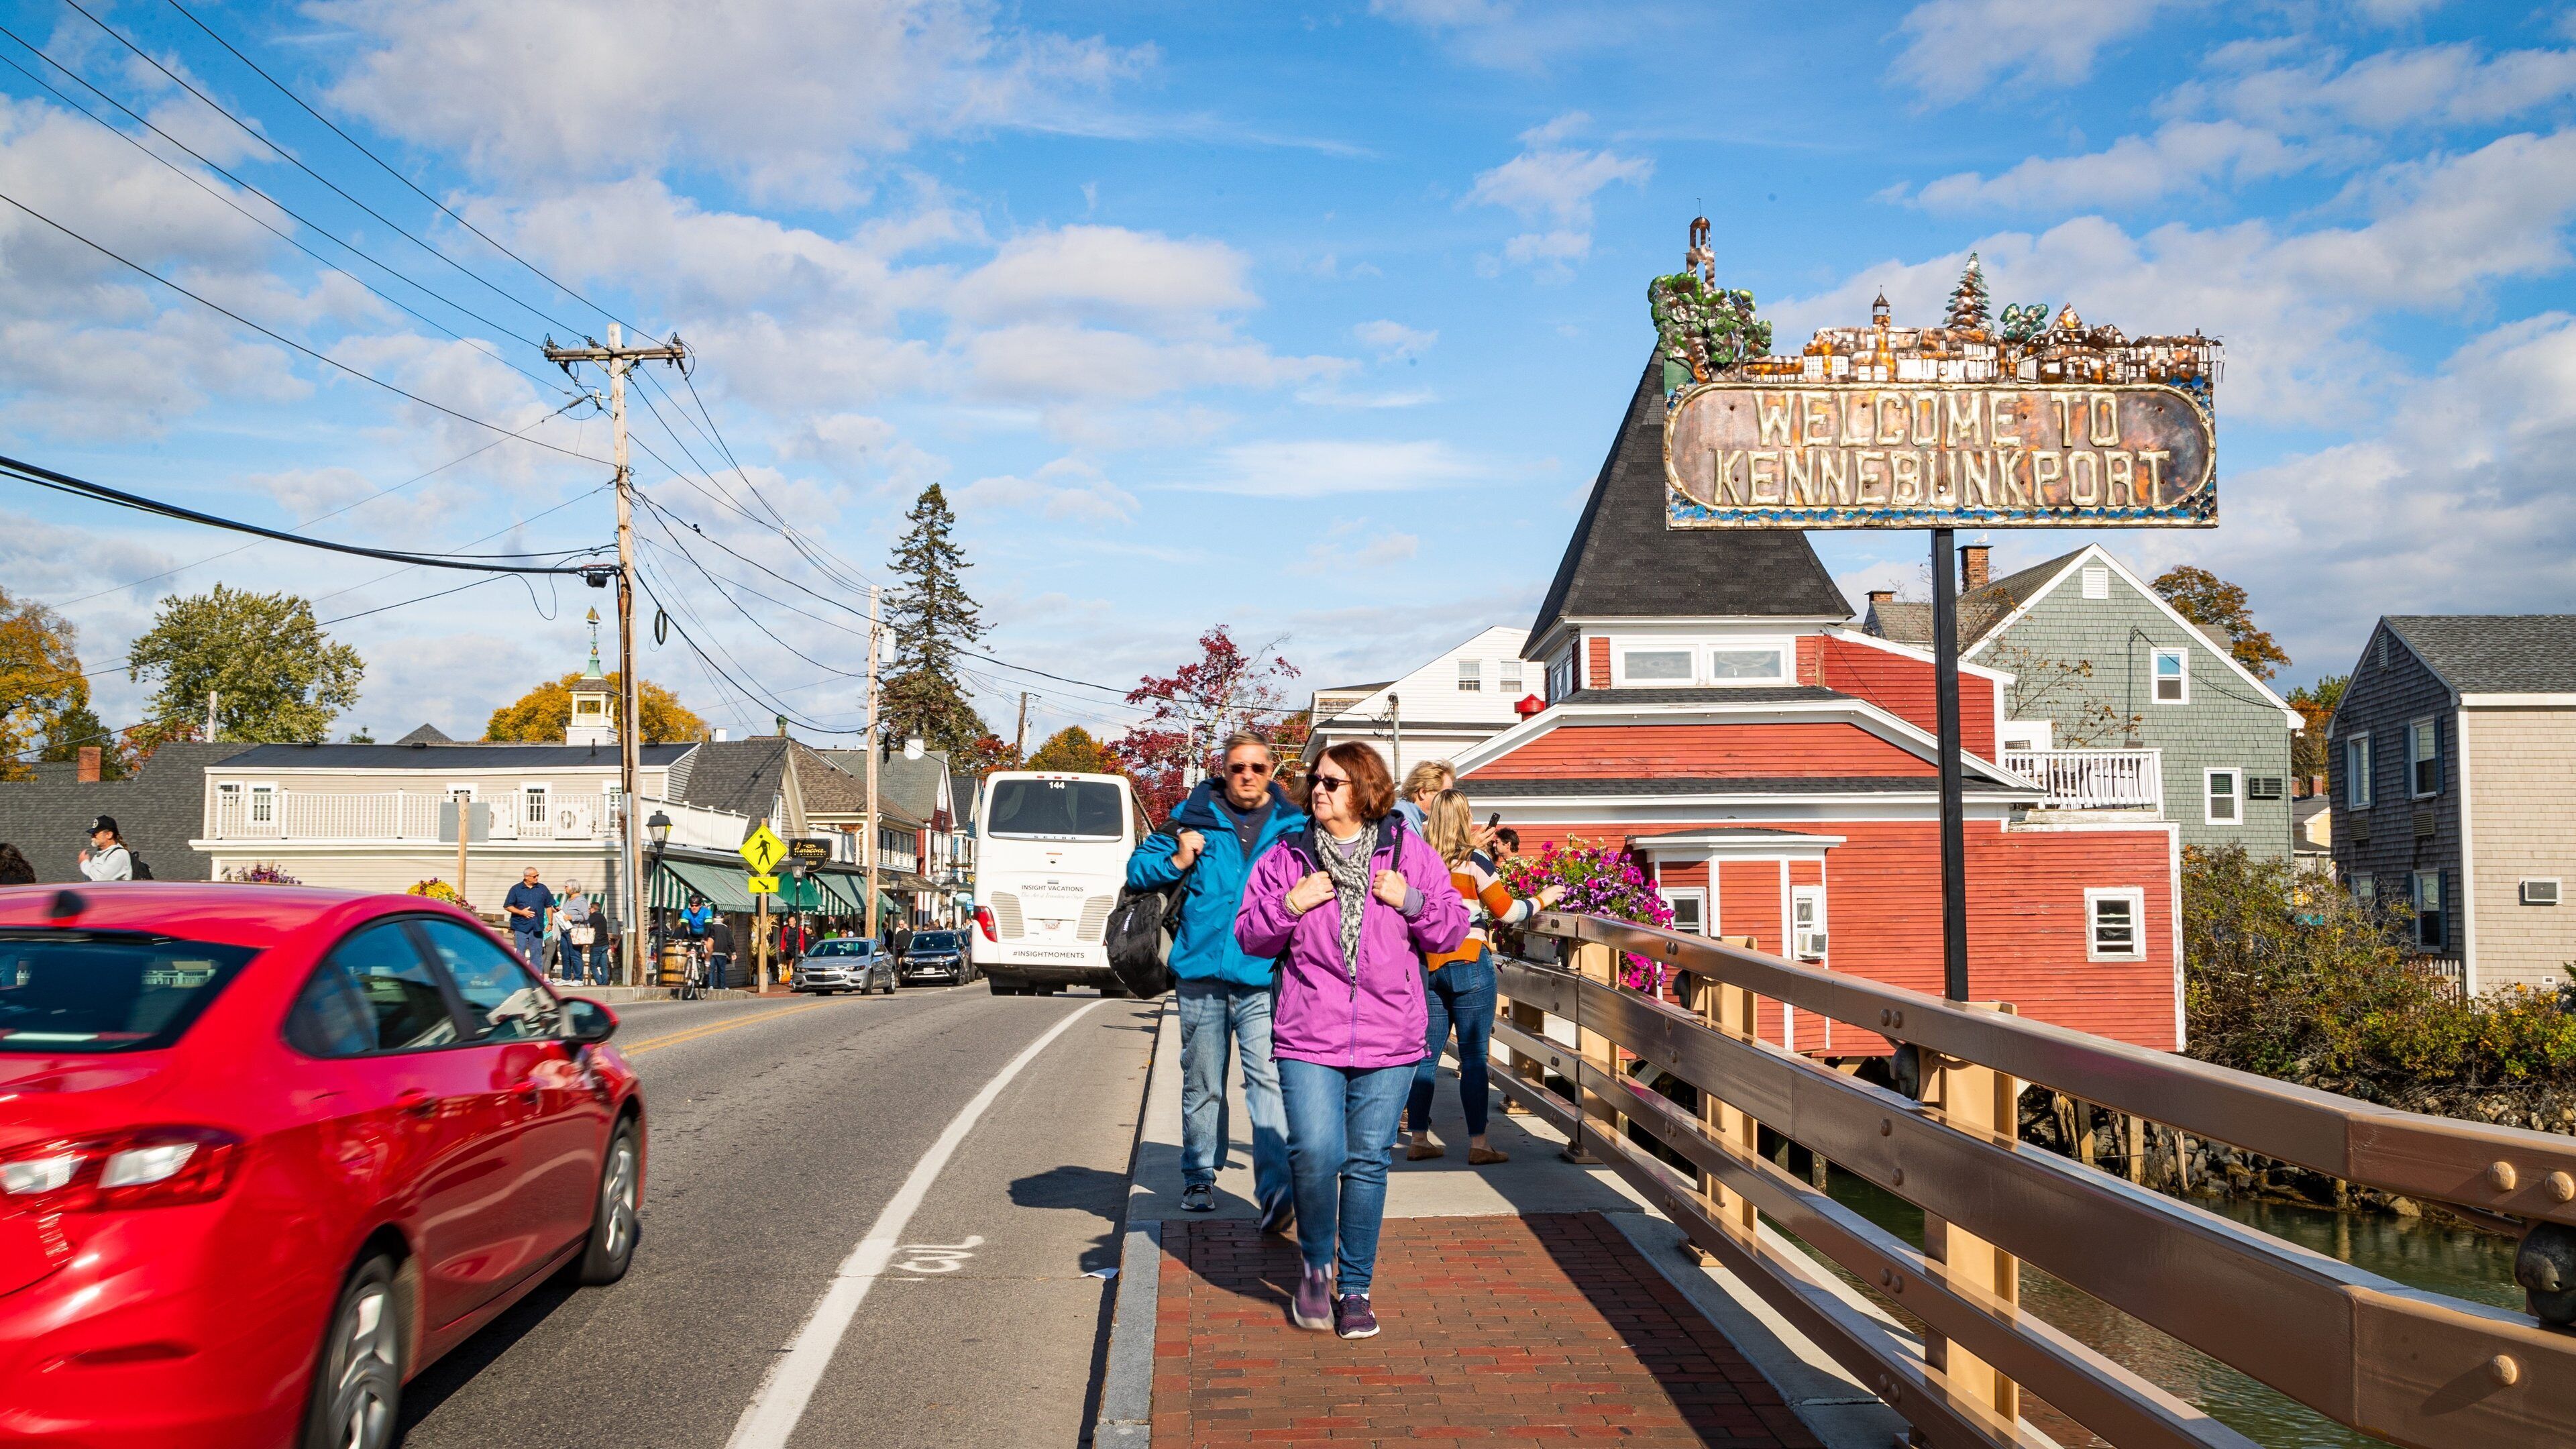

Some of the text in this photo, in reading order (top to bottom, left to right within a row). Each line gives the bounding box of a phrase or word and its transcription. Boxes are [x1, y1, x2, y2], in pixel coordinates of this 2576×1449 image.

[1754, 391, 2119, 447] WELCOME TO
[1713, 449, 2170, 506] KENNEBUNKPORT
[1013, 951, 1085, 959] #INSIGHTMOMENTS
